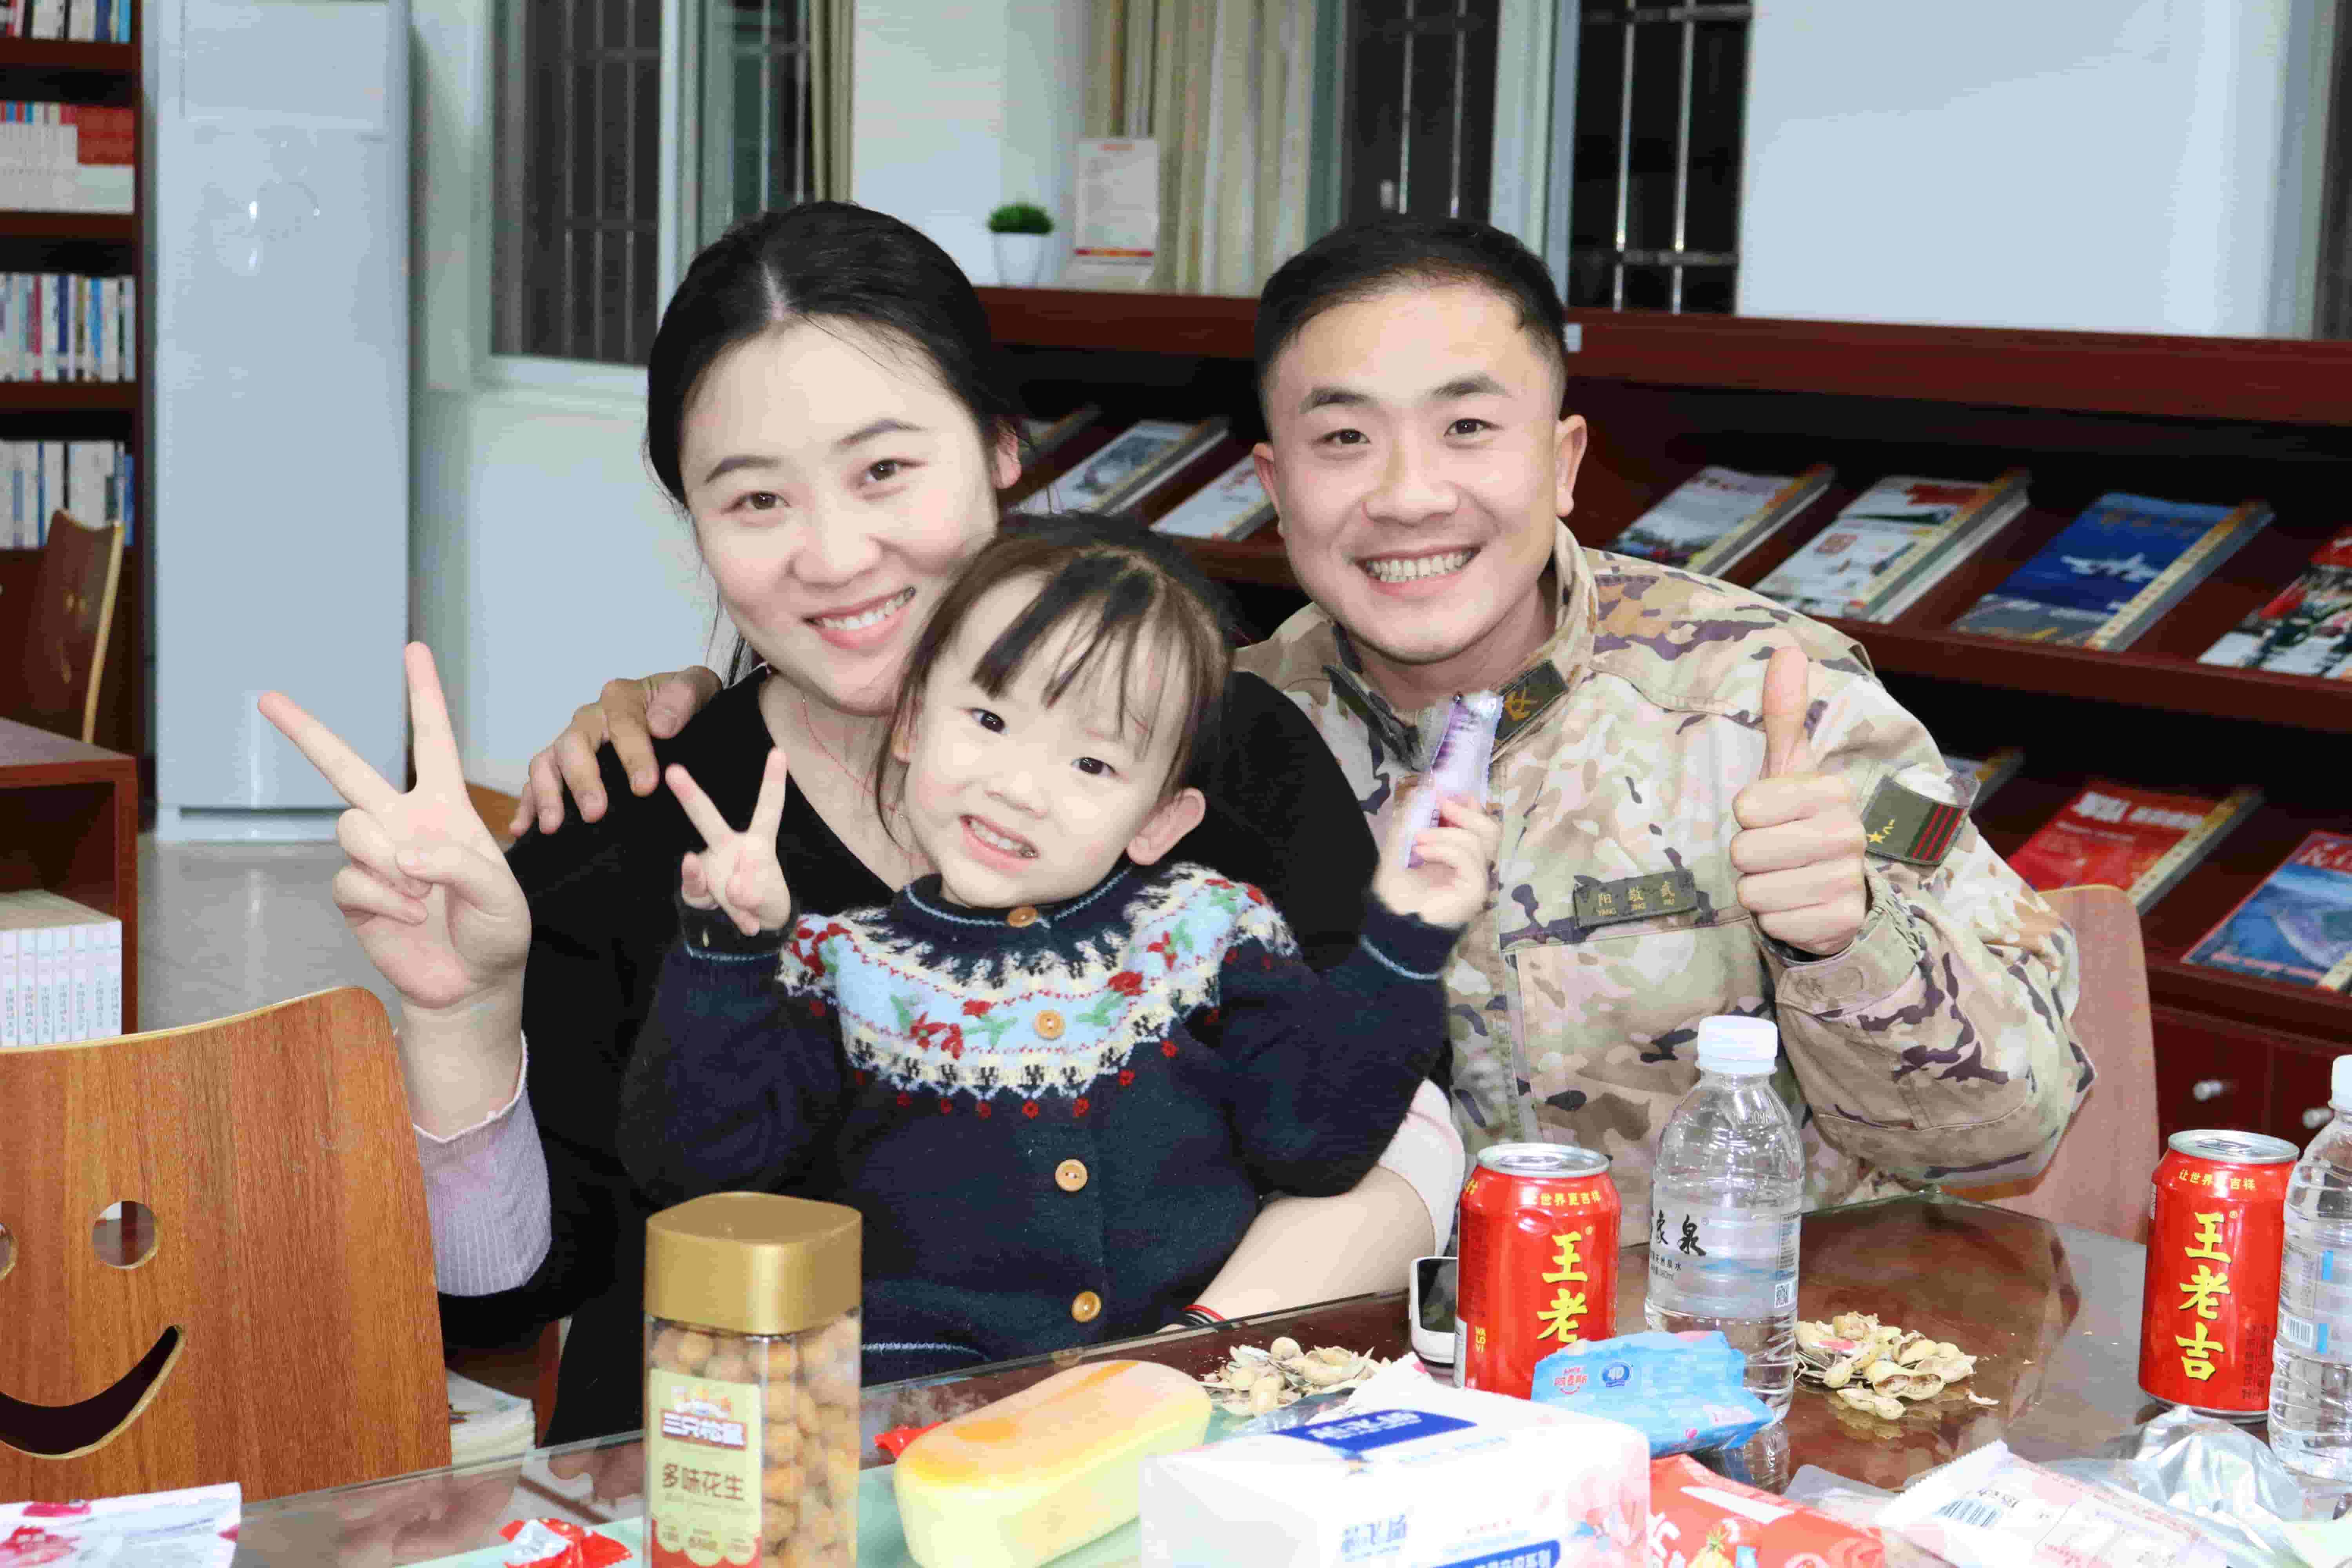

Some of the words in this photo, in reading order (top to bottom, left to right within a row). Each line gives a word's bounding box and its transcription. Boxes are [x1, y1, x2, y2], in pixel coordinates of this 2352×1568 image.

[1530, 1189, 1602, 1207] 世界更吉祥
[1536, 1231, 1588, 1343] 王老
[2175, 1211, 2232, 1382] 王老吉
[662, 1463, 745, 1501] 多味花生
